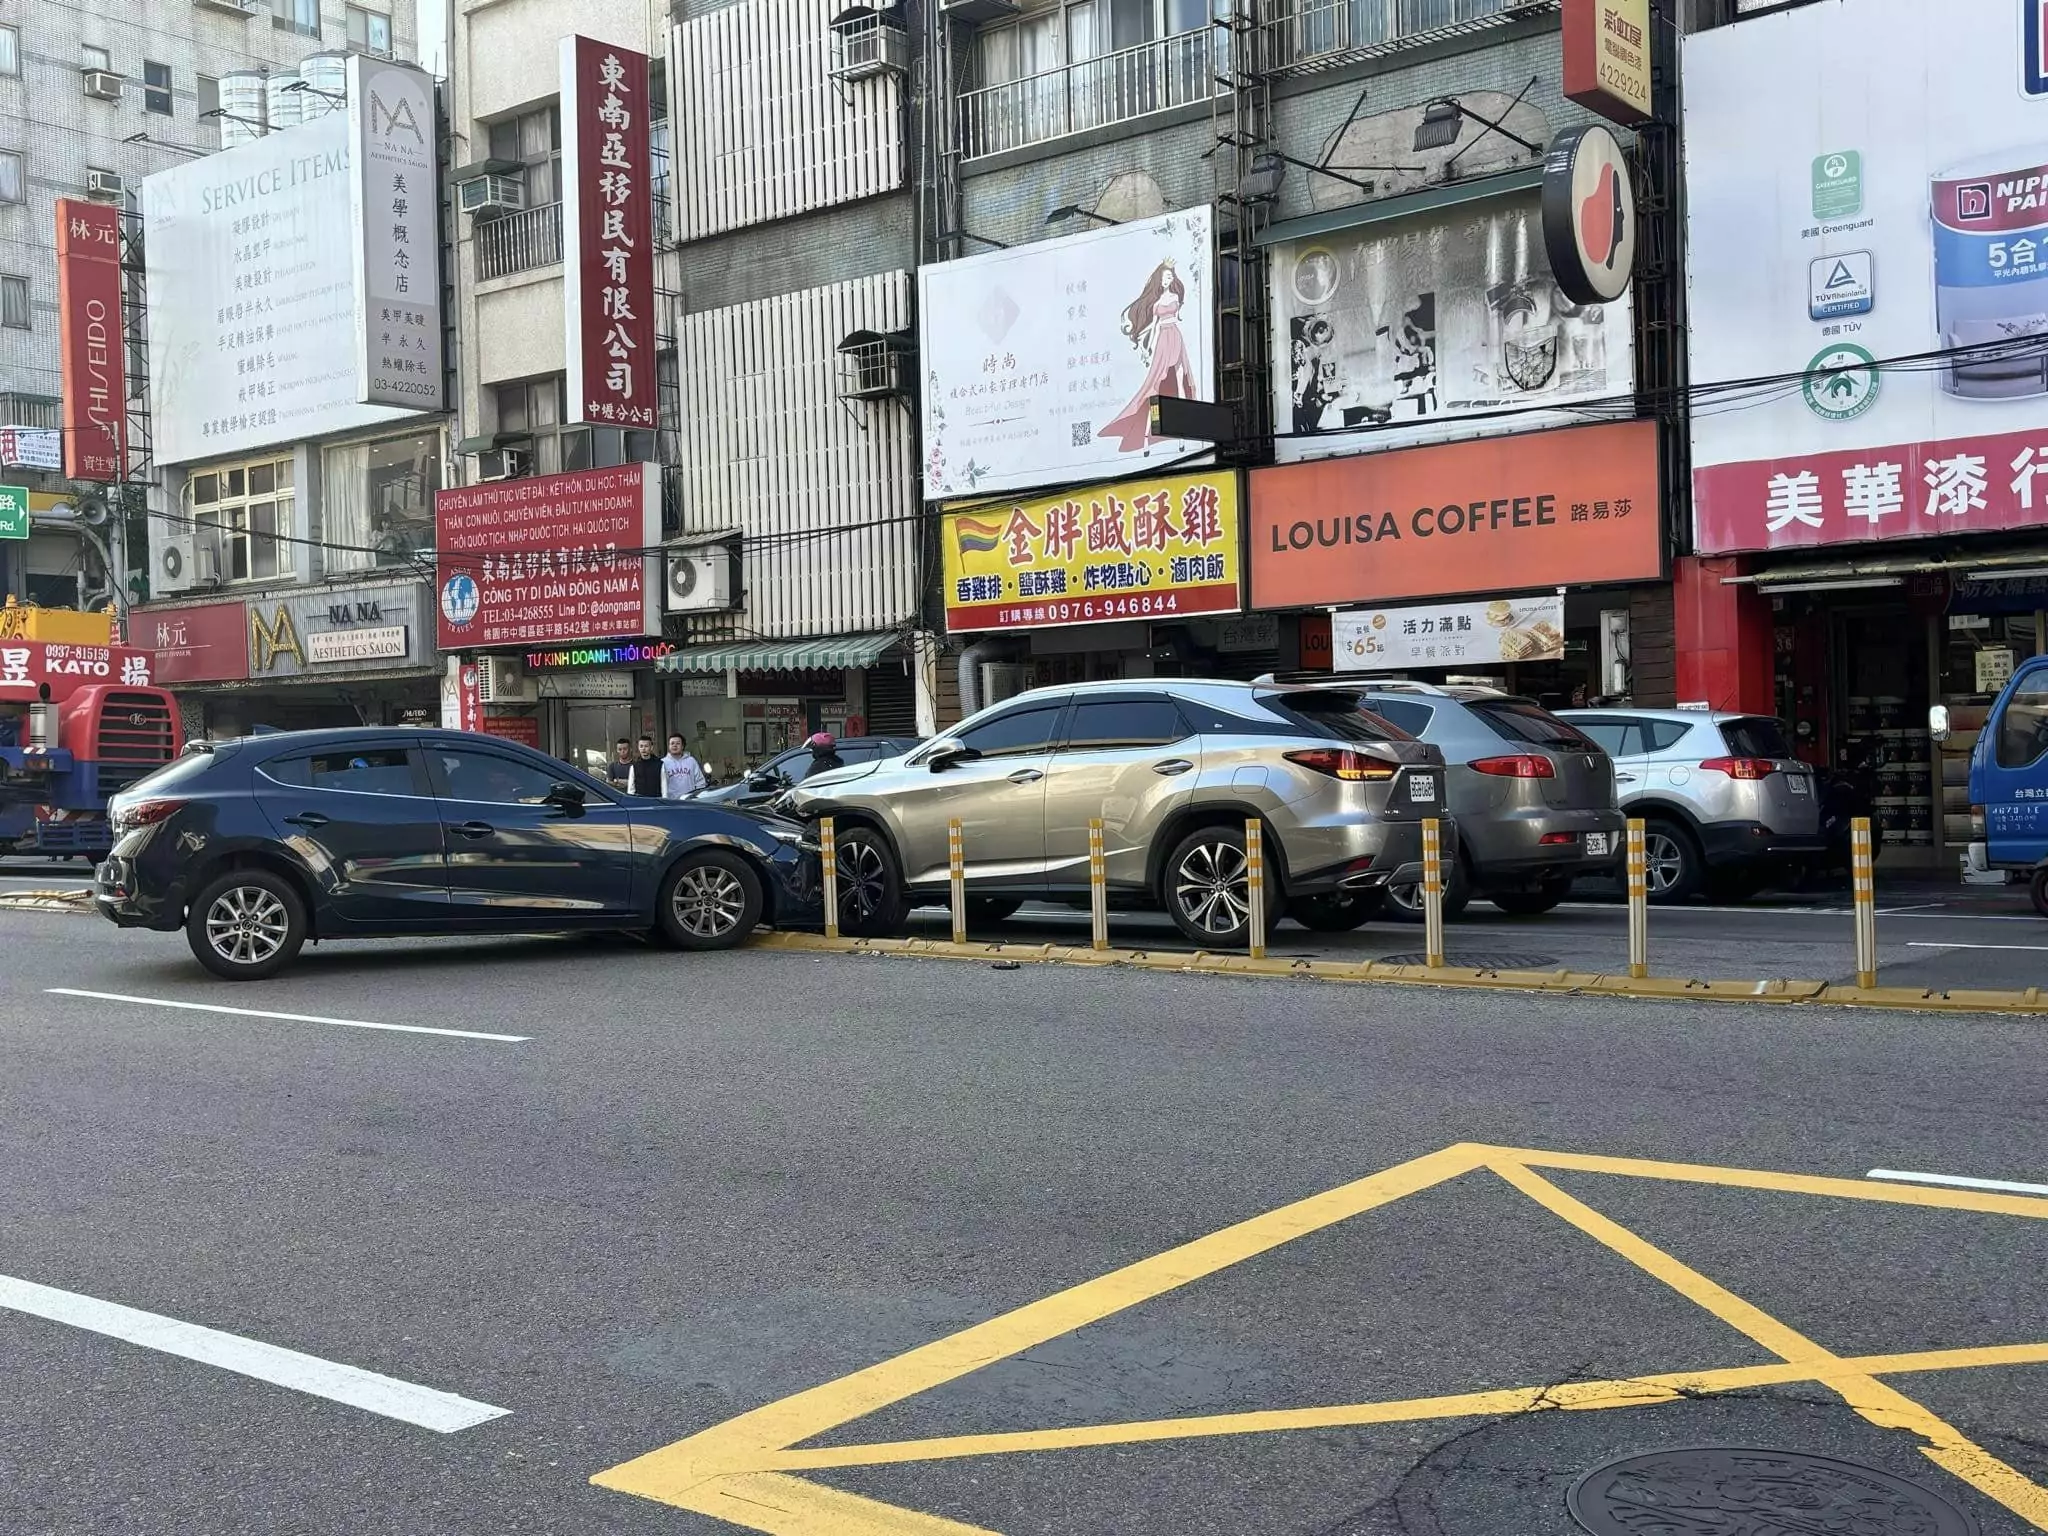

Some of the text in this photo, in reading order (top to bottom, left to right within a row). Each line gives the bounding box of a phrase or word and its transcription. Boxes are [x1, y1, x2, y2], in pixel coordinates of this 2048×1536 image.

[1604, 8, 1642, 49] 彩虹屋
[1600, 62, 1647, 102] 4229224
[202, 168, 282, 215] SERVICE
[2007, 191, 2048, 213] PAI
[70, 217, 115, 245] 林元
[392, 173, 409, 293] 美學概念店
[597, 53, 637, 401] 東南亞移民有限公司
[1822, 218, 1874, 235] Greenguard
[1822, 301, 1860, 313] CERTIFIED
[381, 333, 426, 351] 半永久
[87, 299, 112, 440] SHISEIDO
[381, 357, 427, 375] 熱蠟除毛
[983, 352, 1016, 374] 時尚
[374, 378, 436, 396] 03-4220052
[587, 399, 654, 425] 中壢分公司
[83, 455, 117, 472] 資生堂
[585, 478, 597, 492] DU
[466, 514, 481, 528] CON
[584, 499, 603, 513] KINH
[1272, 494, 1633, 553] LOUISA COFFEE 路易莎
[1003, 486, 1223, 565] 金胖鹹酥雞
[482, 542, 616, 584] 東南亞移民有限公司
[483, 586, 512, 604] CÔNG
[515, 587, 528, 601] TY
[530, 585, 541, 600] DI
[544, 580, 566, 599] DÂN
[603, 578, 628, 594] NAM
[631, 572, 640, 591] Á
[482, 605, 554, 623] TEL:03-4268555
[559, 603, 575, 617] Line
[999, 594, 1178, 623] 訂購專線 0976-946844
[156, 621, 187, 648] 林元
[447, 622, 475, 633] TRAVEL
[1403, 615, 1472, 634] 活力滿點
[45, 644, 110, 661] 0937-815159
[313, 641, 401, 660] AESTHETICS SALON
[544, 652, 569, 666] KINH
[1411, 644, 1466, 658] 早餐派對
[45, 659, 110, 676] KATO
[667, 766, 691, 779] CANADA
[2015, 788, 2048, 798] 台灣立
